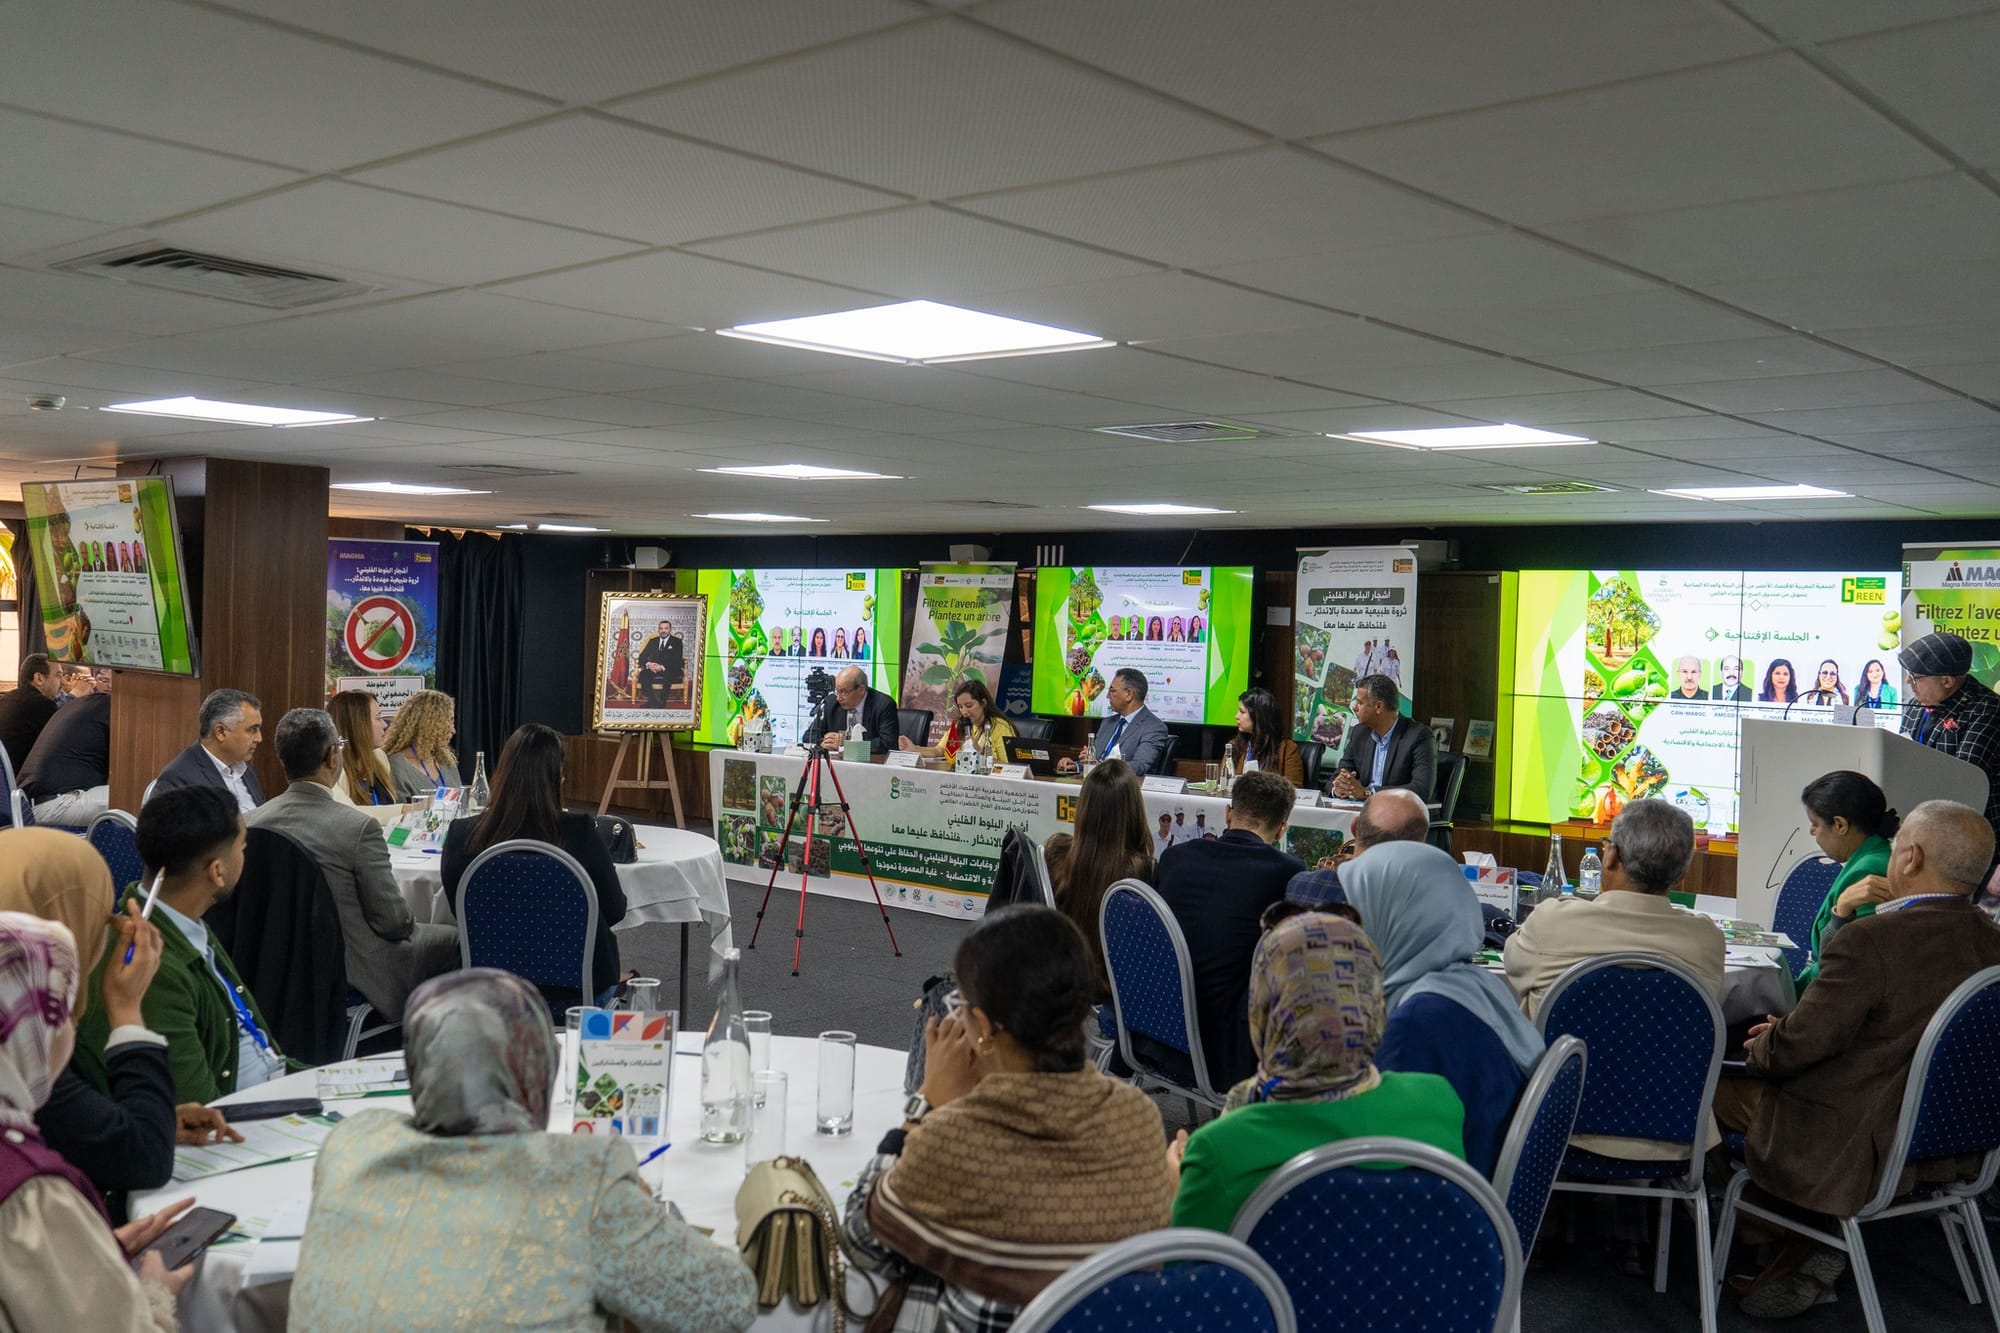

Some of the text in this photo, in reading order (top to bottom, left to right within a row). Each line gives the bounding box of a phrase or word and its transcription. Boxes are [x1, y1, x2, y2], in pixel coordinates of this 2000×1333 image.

[1322, 589, 1391, 604] أشجار البلوط الفليني
[1841, 578, 1883, 603] GREEN
[922, 598, 949, 609] Filtrez
[928, 610, 1001, 622] Plantez un arbre
[1341, 607, 1363, 615] مهددة
[1365, 606, 1390, 617] طبيعية
[1391, 605, 1407, 617] ثروة
[1916, 603, 2000, 620] Filtrez l'ave
[1338, 621, 1355, 631] عليها
[1357, 620, 1387, 630] فلنحافظ
[1773, 630, 1810, 644] الجلسة
[1670, 710, 1707, 718] CAN-MAROC
[947, 814, 976, 829] الفليني
[978, 816, 1004, 832] البلوط
[892, 823, 905, 834] معا
[907, 825, 928, 839] عليها
[885, 848, 897, 858] على
[898, 848, 919, 859] الحفاظ
[948, 857, 968, 867] البلوط
[898, 862, 925, 875] المعمورة
[945, 870, 981, 883] الاقتصادية
